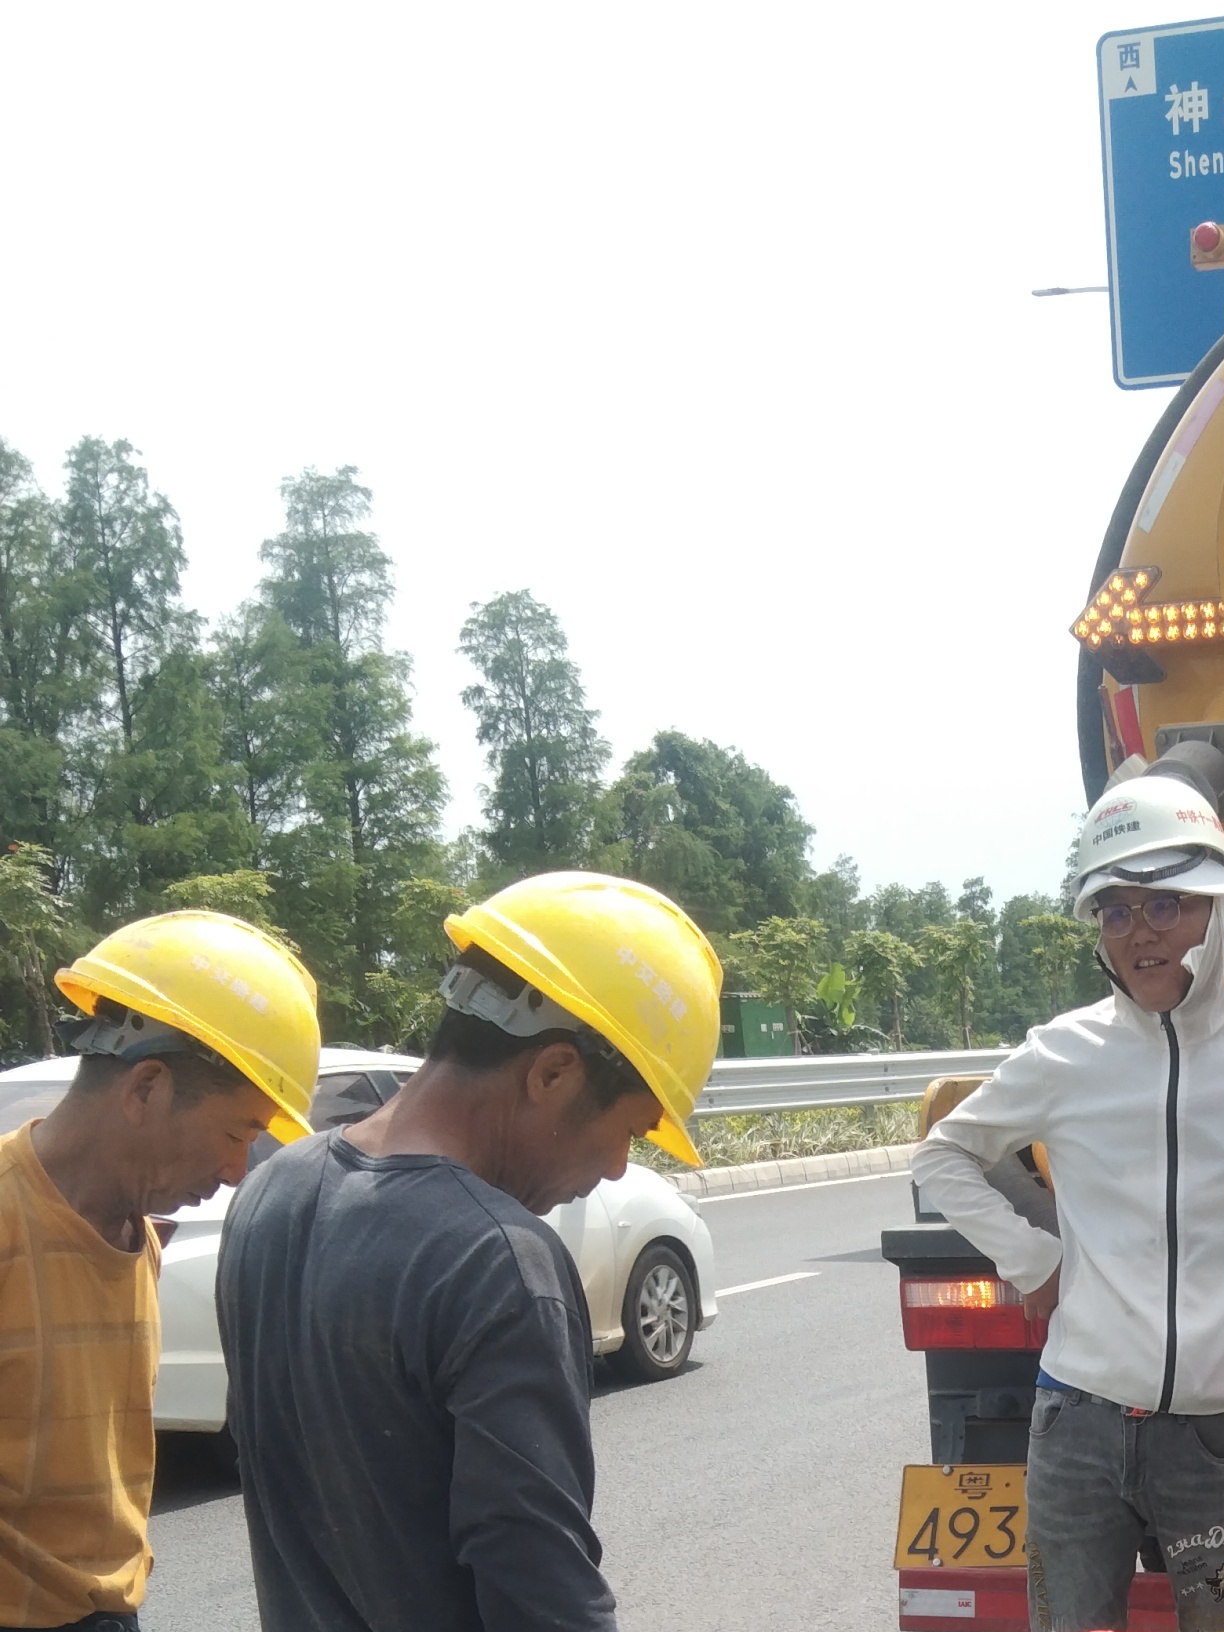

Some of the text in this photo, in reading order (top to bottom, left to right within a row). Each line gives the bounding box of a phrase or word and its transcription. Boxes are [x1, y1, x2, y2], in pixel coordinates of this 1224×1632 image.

[1117, 42, 1141, 72] 西
[1092, 820, 1142, 847] 中国铁建
[954, 1472, 993, 1500] 粤
[907, 1505, 1027, 1561] 493
